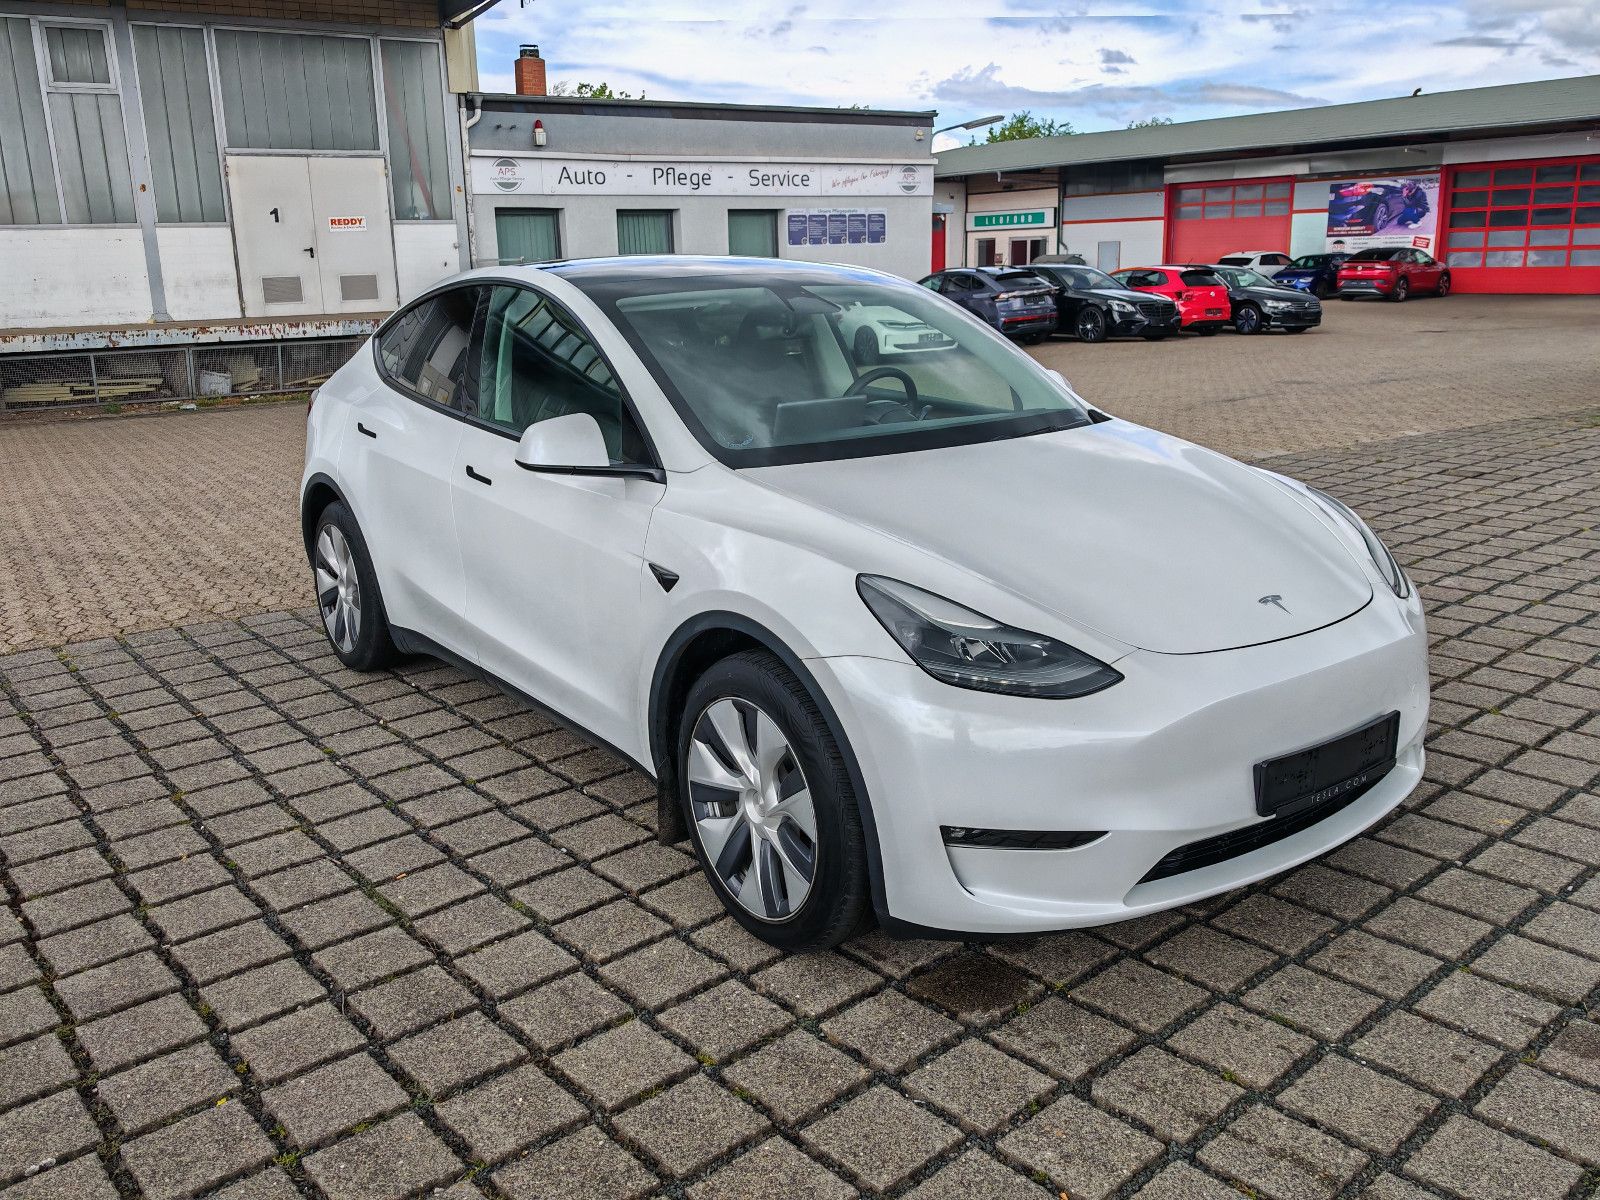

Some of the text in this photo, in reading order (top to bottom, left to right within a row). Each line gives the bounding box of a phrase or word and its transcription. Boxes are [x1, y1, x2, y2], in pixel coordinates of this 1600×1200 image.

[497, 167, 516, 176] APS
[558, 166, 606, 185] Auto
[652, 167, 712, 190] Pflege
[749, 169, 810, 187] Service
[902, 172, 916, 181] APS
[269, 207, 280, 223] 1
[330, 218, 363, 226] REDDY
